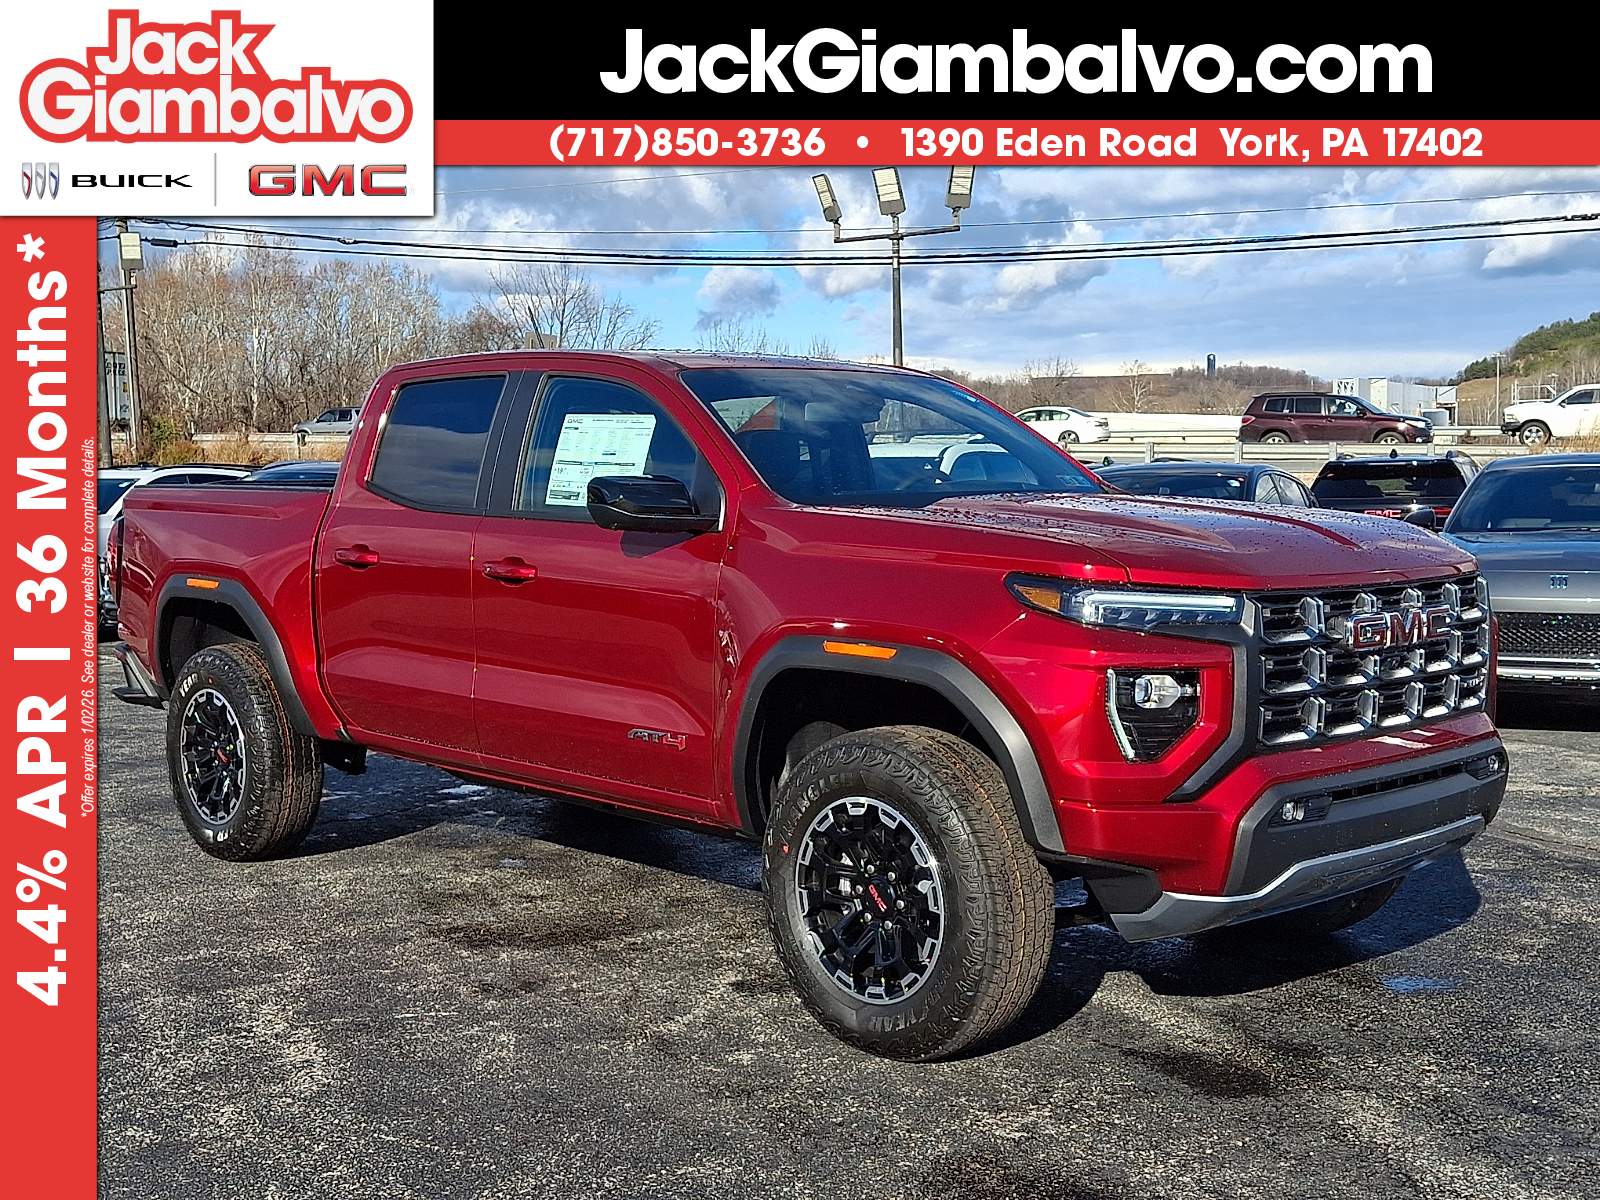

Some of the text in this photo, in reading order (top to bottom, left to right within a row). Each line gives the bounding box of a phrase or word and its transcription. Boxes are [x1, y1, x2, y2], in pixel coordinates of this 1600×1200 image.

[1364, 509, 1402, 518] GMC
[1348, 606, 1452, 650] GMC
[627, 728, 686, 751] AT4
[868, 884, 888, 912] GMC
